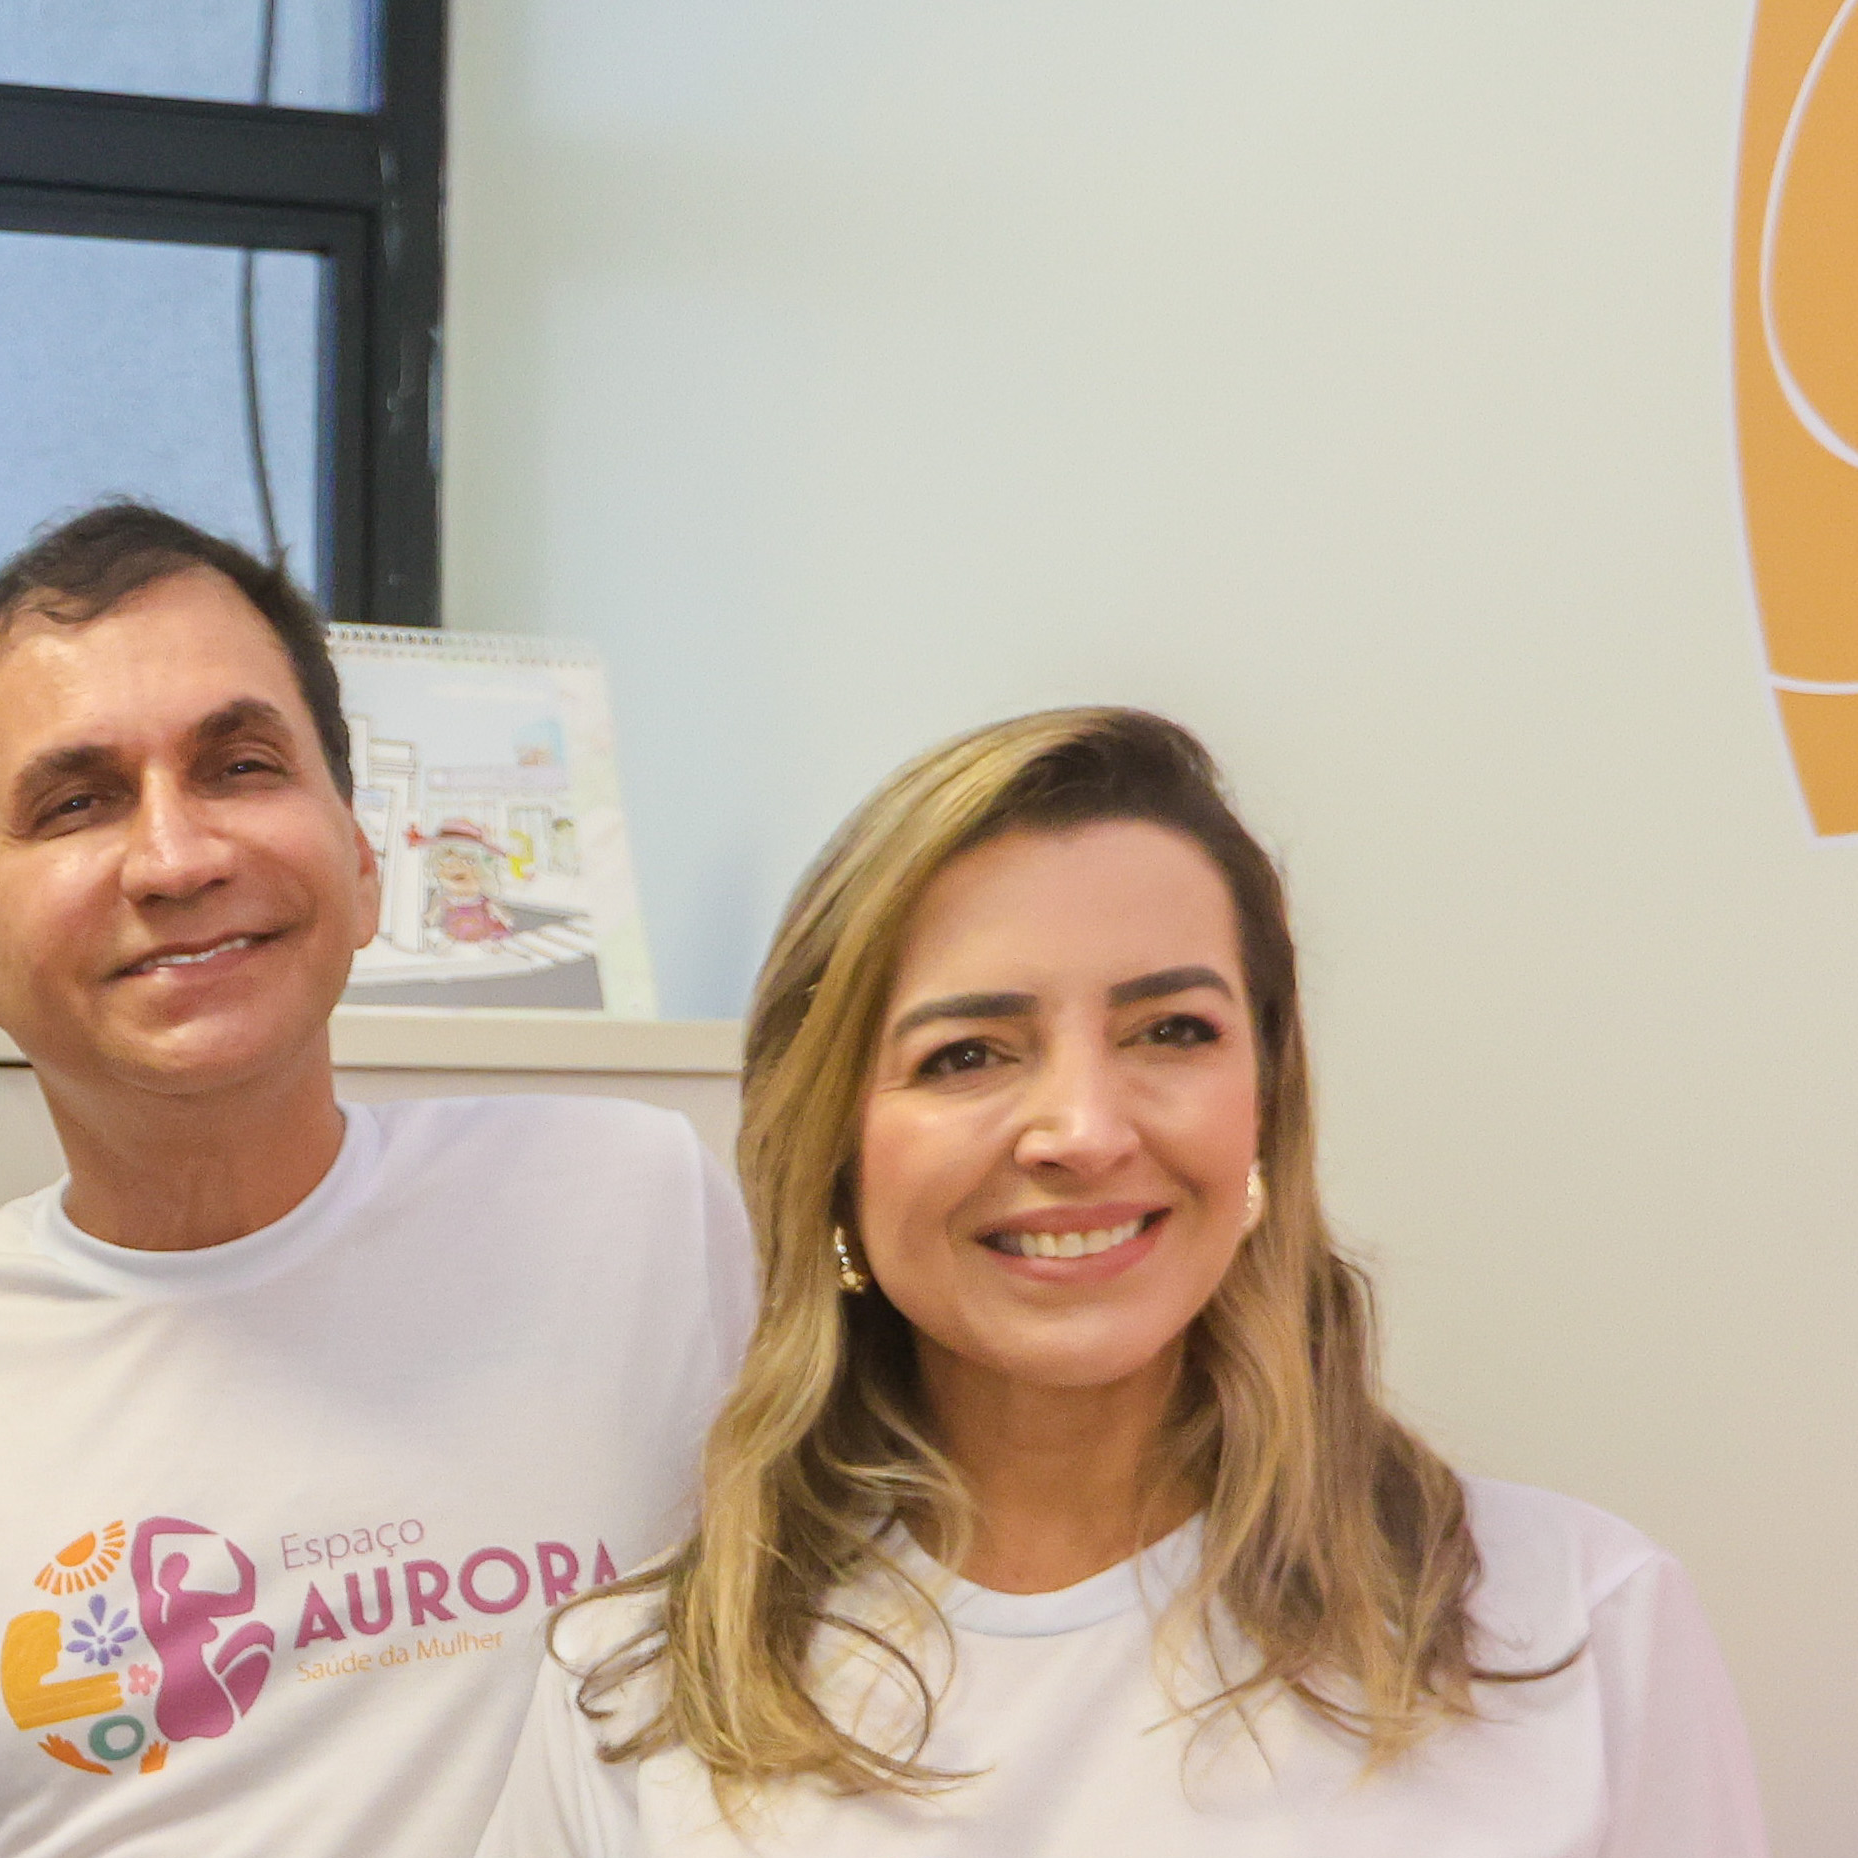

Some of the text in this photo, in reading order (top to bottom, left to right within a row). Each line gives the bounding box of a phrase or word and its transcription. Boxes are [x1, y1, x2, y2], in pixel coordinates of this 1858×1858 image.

[279, 1517, 425, 1571] Espaço
[295, 1631, 503, 1682] Saúde da Mulher
